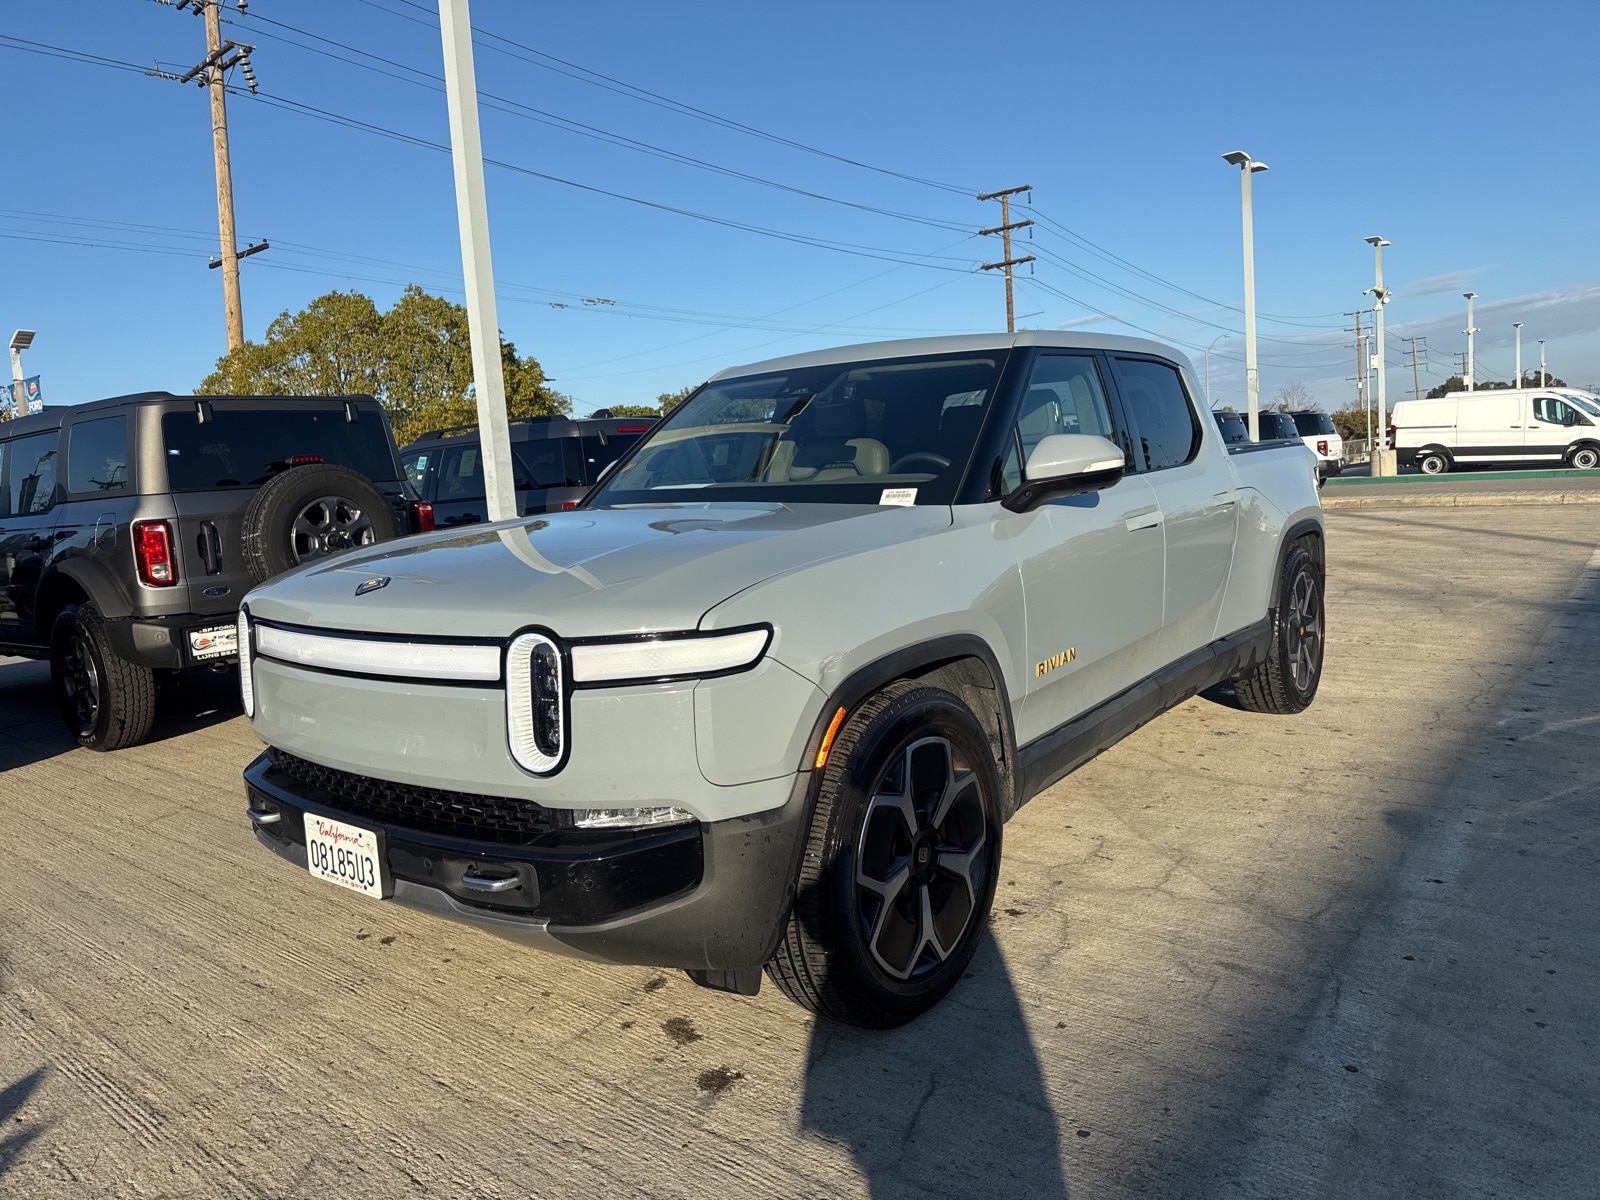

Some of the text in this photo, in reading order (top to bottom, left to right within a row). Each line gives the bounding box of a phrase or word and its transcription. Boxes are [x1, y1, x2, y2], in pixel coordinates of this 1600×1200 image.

[29, 400, 43, 412] FORD
[197, 649, 238, 661] LONG BEA
[1035, 647, 1076, 678] RIVIAN
[319, 821, 364, 848] California
[310, 839, 375, 888] 08185U3
